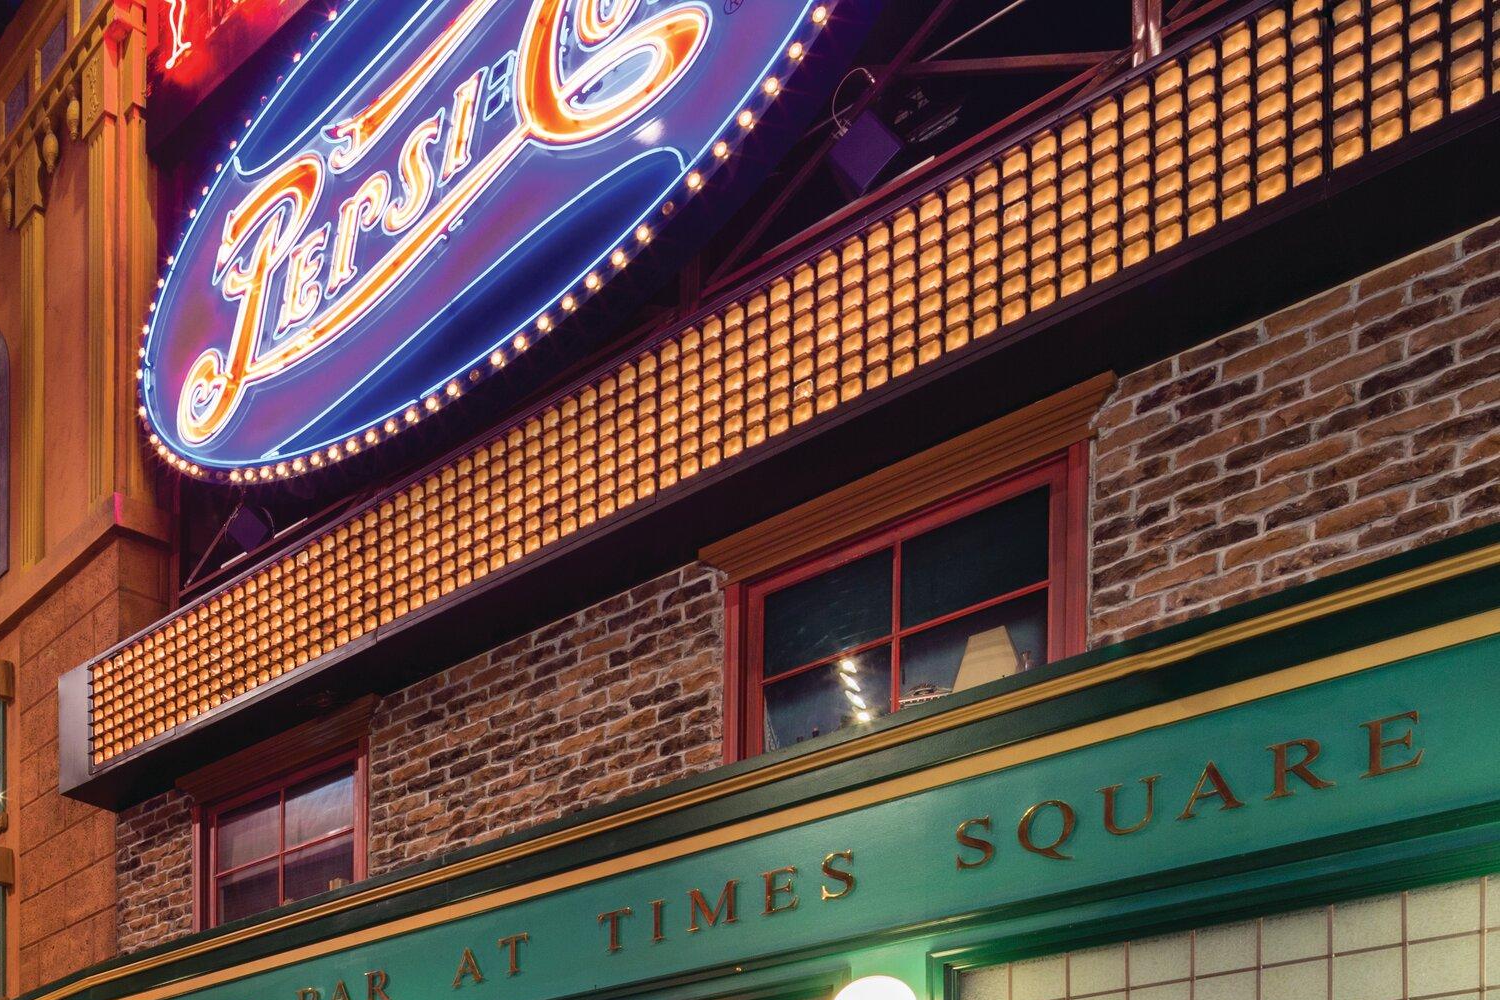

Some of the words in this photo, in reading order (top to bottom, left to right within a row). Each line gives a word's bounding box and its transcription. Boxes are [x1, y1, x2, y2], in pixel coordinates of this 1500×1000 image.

[452, 932, 530, 989] AT
[597, 850, 858, 953] TIMES
[955, 709, 1427, 870] SQUARE
